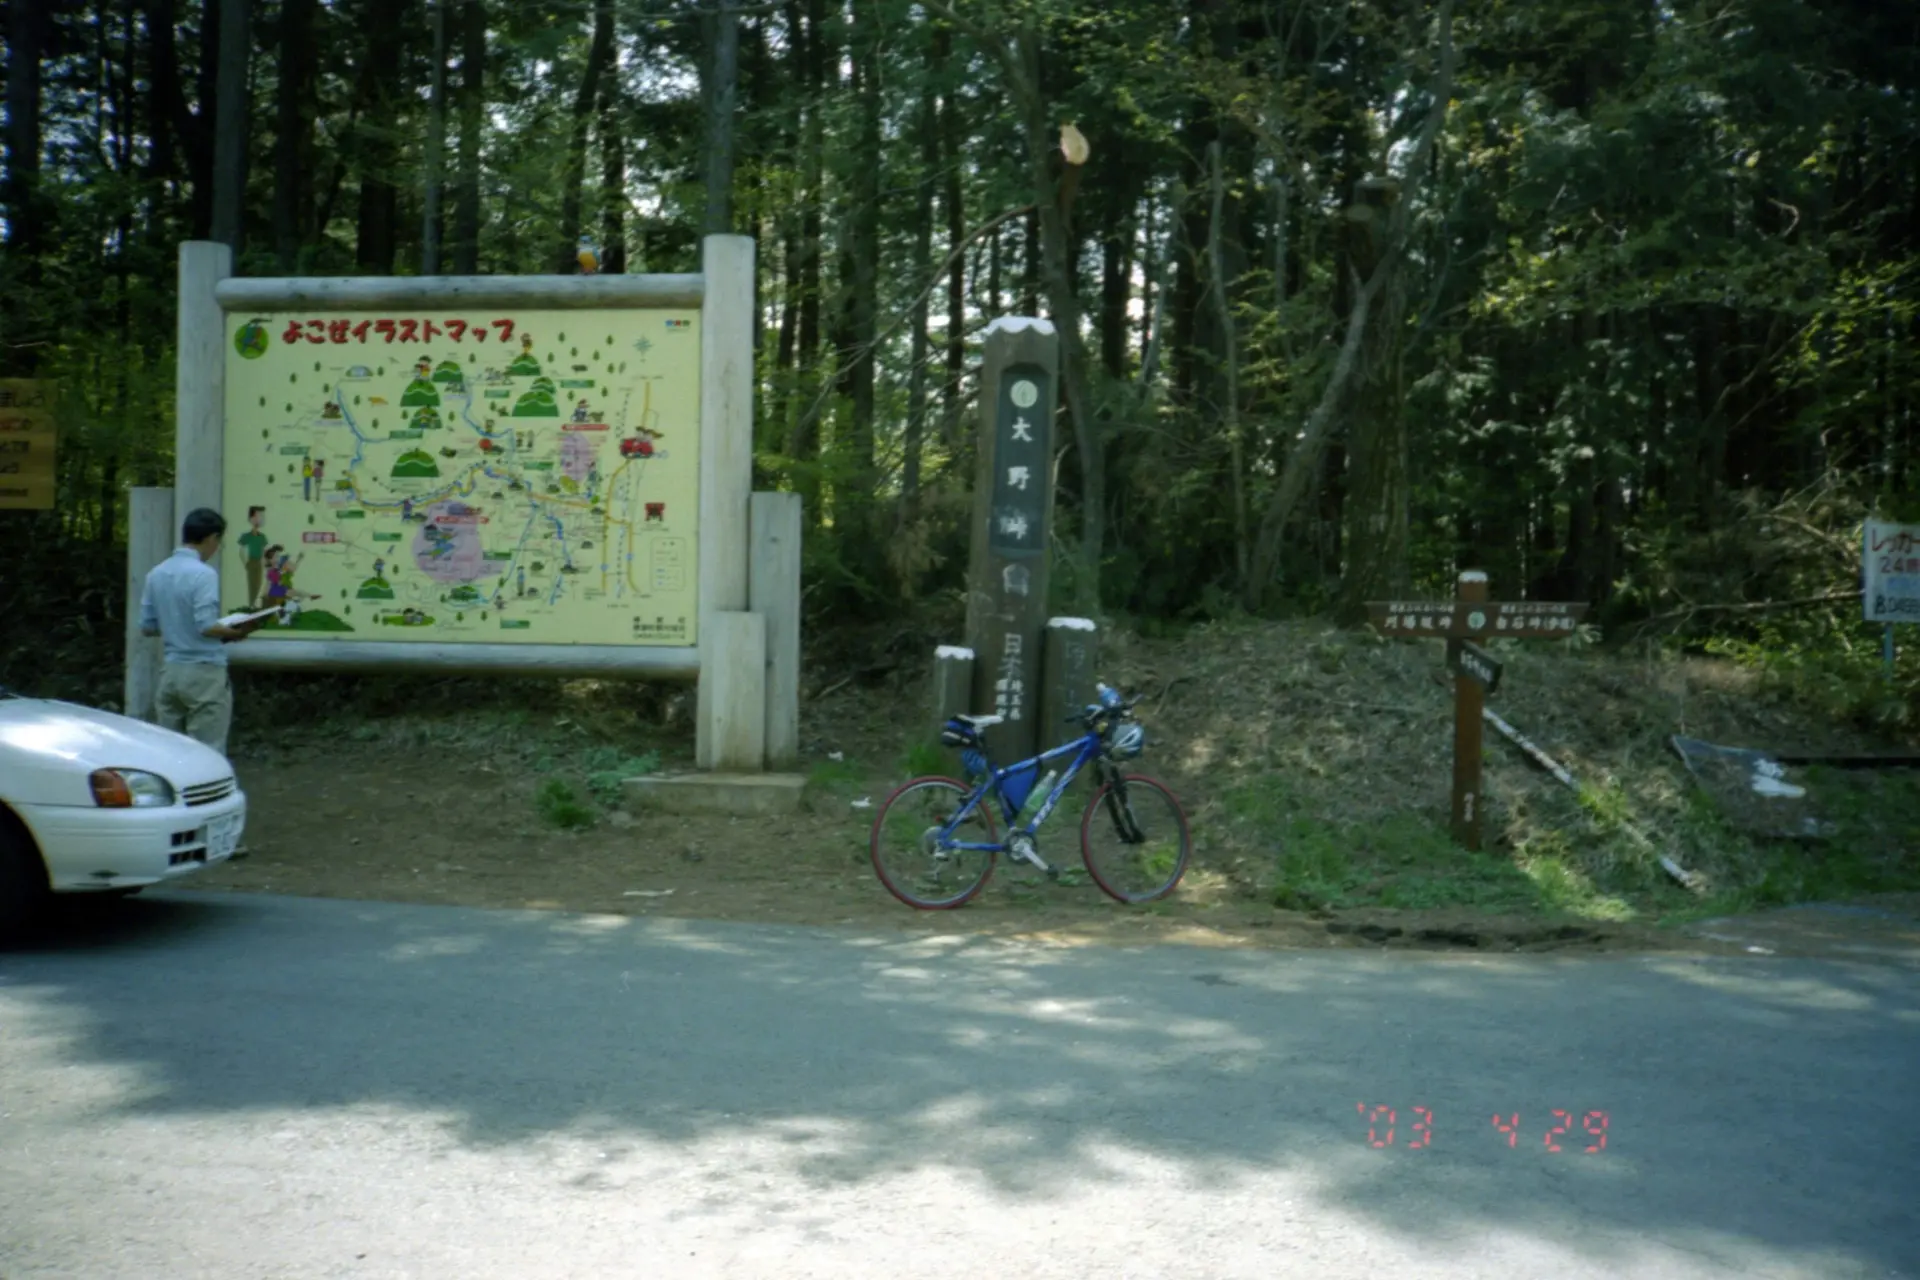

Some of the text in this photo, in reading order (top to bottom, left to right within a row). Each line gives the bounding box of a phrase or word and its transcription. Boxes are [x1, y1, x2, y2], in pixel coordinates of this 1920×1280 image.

[282, 319, 515, 344] よこぜイラストマップ
[1000, 416, 1033, 540] 大野峠
